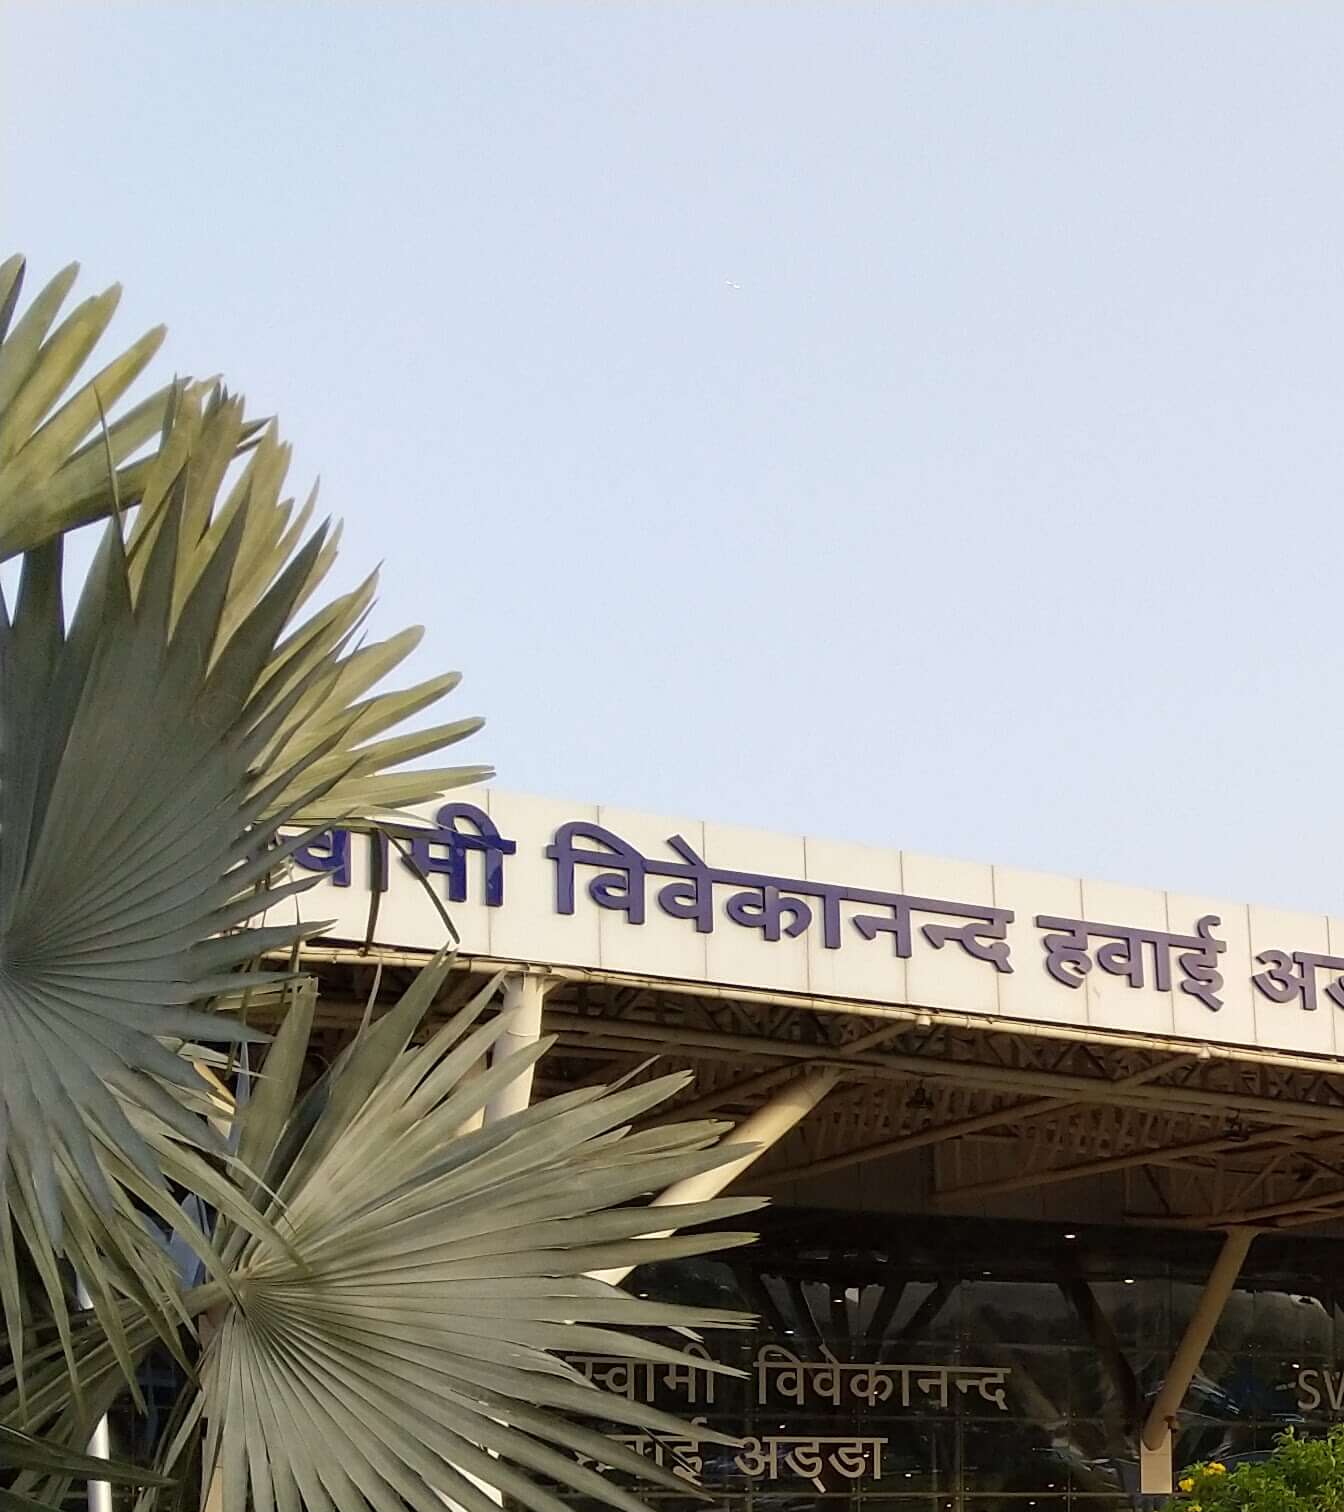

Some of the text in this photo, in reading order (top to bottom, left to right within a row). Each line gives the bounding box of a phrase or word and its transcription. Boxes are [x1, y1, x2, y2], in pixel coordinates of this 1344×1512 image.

[546, 820, 1015, 973] विवेकानन्द
[1036, 914, 1227, 1012] हवाई
[753, 1343, 1012, 1410] विवेकानन्द
